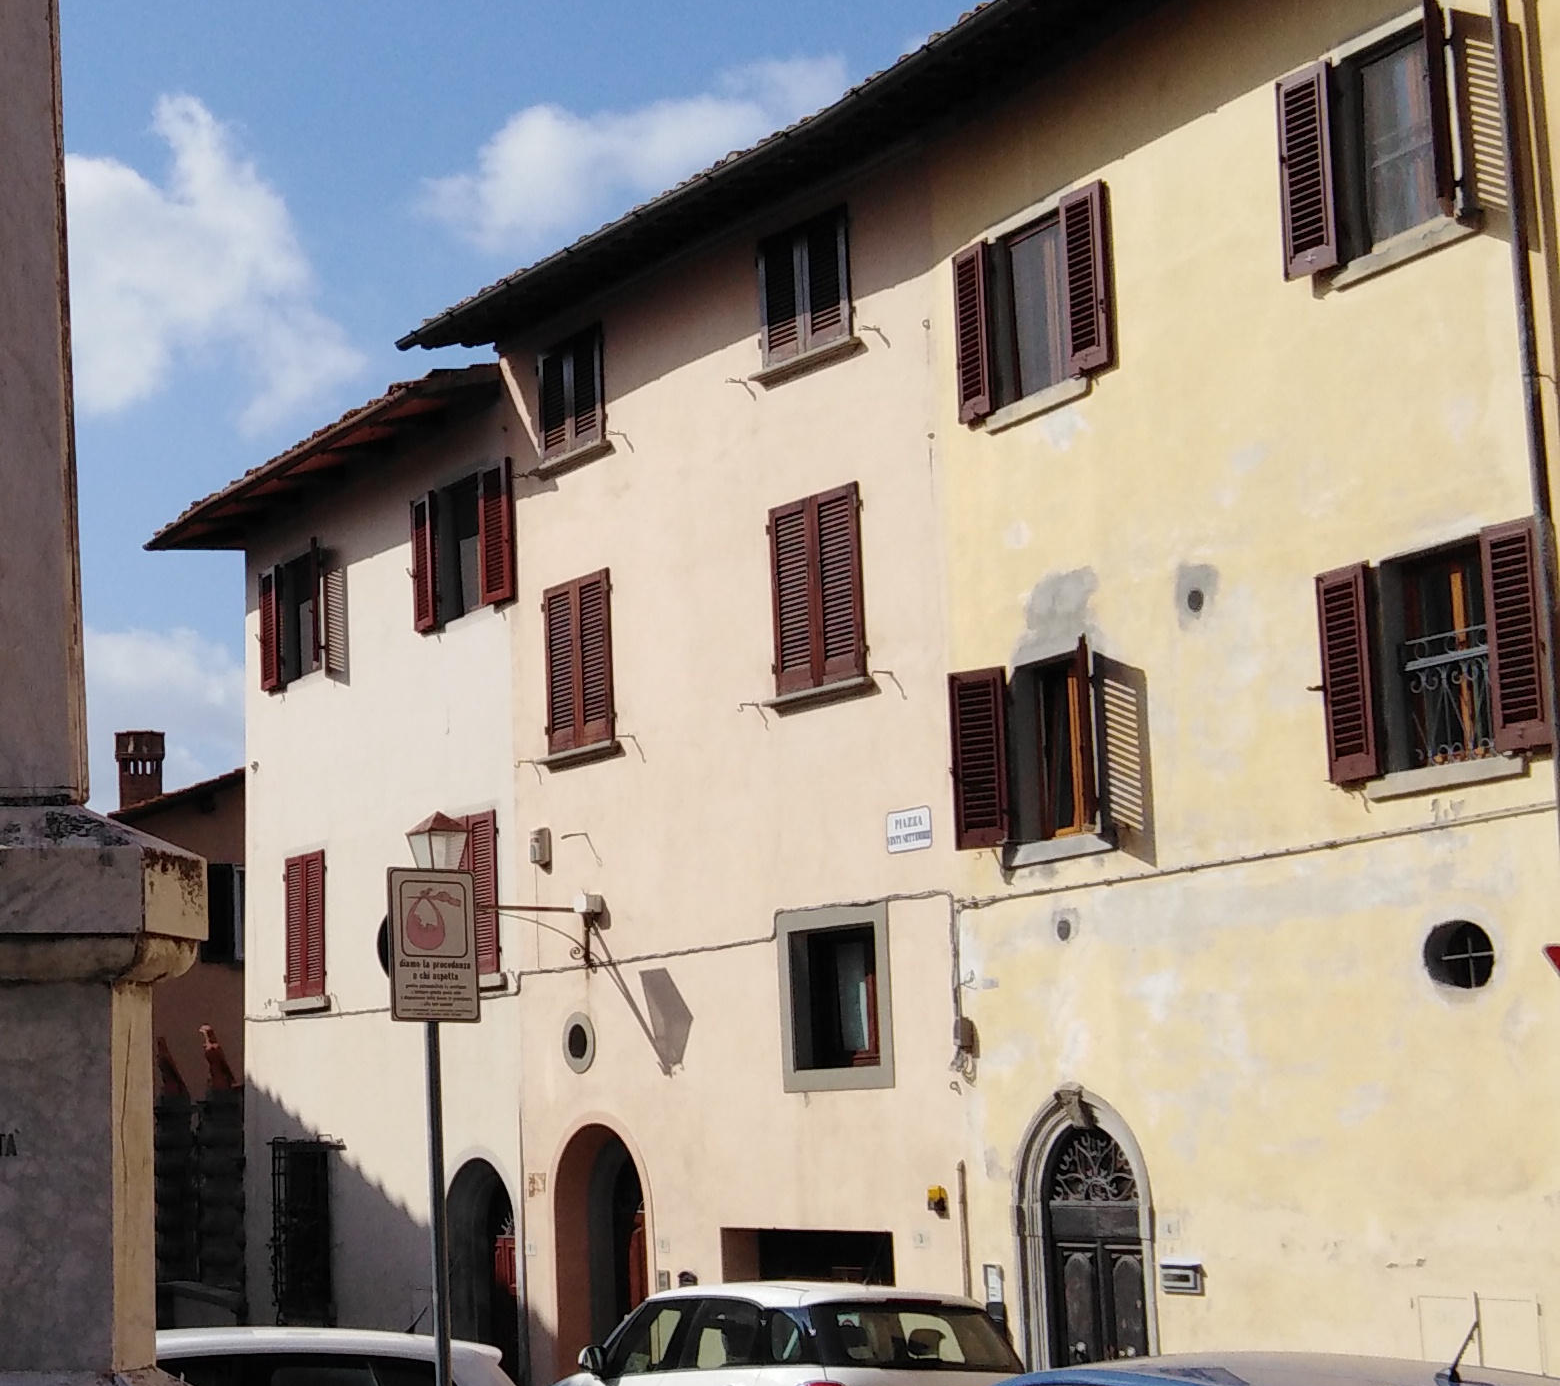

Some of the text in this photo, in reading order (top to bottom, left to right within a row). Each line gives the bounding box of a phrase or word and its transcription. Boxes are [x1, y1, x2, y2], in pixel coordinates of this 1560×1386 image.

[399, 958, 471, 970] diamo la precedenza
[432, 972, 459, 982] aspetta
